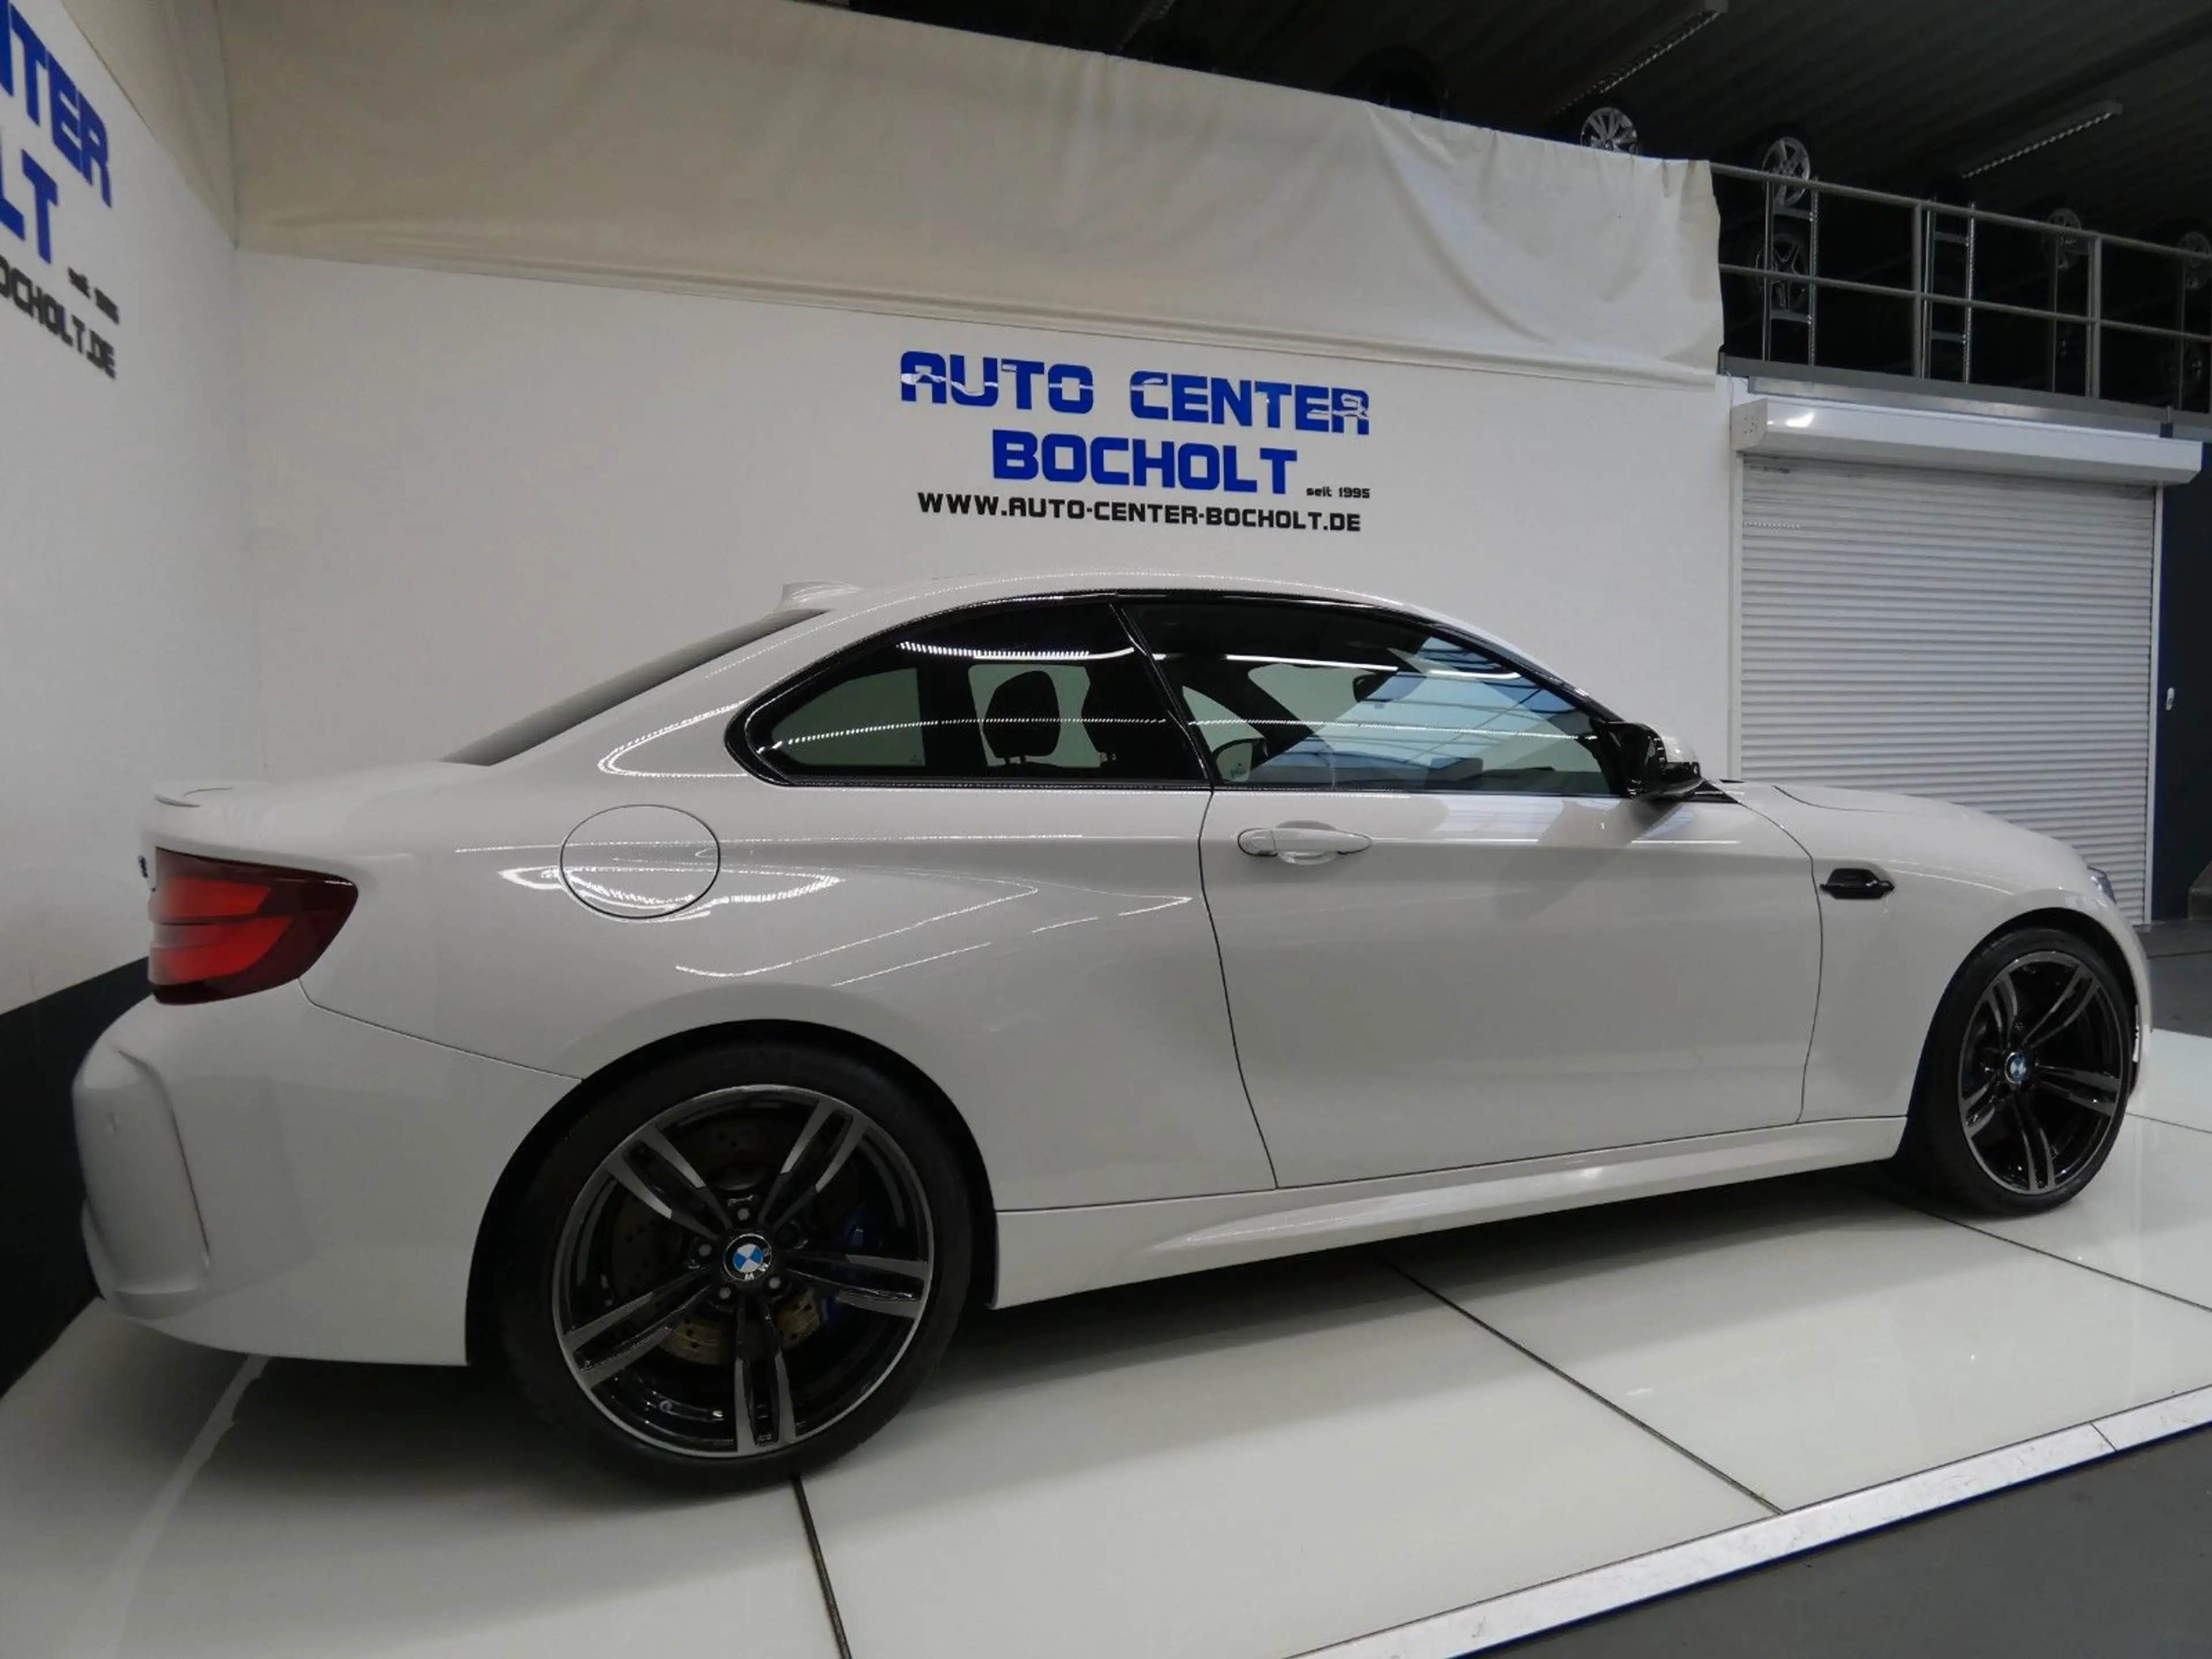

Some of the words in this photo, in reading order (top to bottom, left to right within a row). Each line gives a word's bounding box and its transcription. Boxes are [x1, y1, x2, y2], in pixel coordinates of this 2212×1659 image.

[900, 351, 1094, 415] AUTO
[1131, 370, 1370, 435] CENTER
[992, 429, 1298, 495] BOCHOLT
[918, 492, 1361, 532] WWW.AUTO-CENTER-BOCHOLT.DE
[1306, 486, 1332, 497] seit
[1338, 487, 1370, 499] 1995
